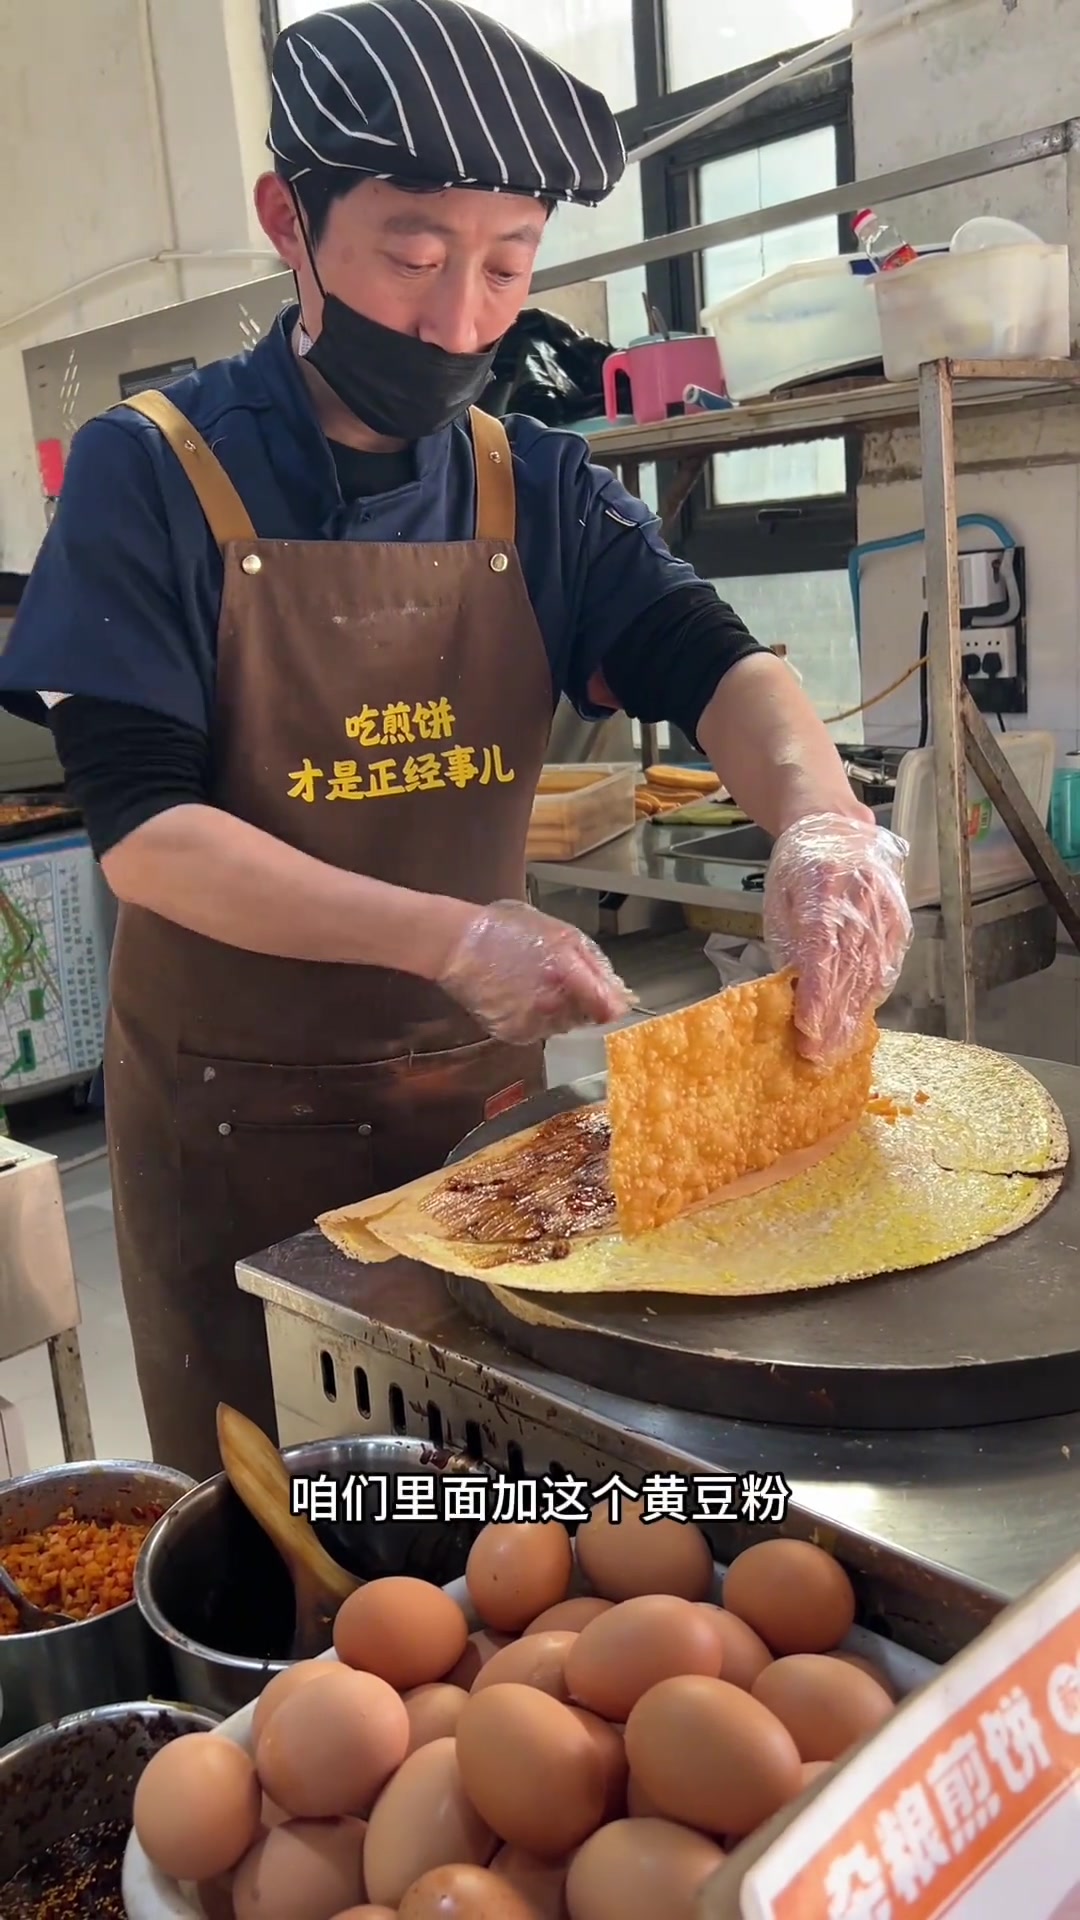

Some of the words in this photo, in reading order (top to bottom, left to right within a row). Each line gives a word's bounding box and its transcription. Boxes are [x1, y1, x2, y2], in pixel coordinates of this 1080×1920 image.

[345, 697, 455, 746] 吃煎饼
[287, 744, 515, 803] 才是正经事儿
